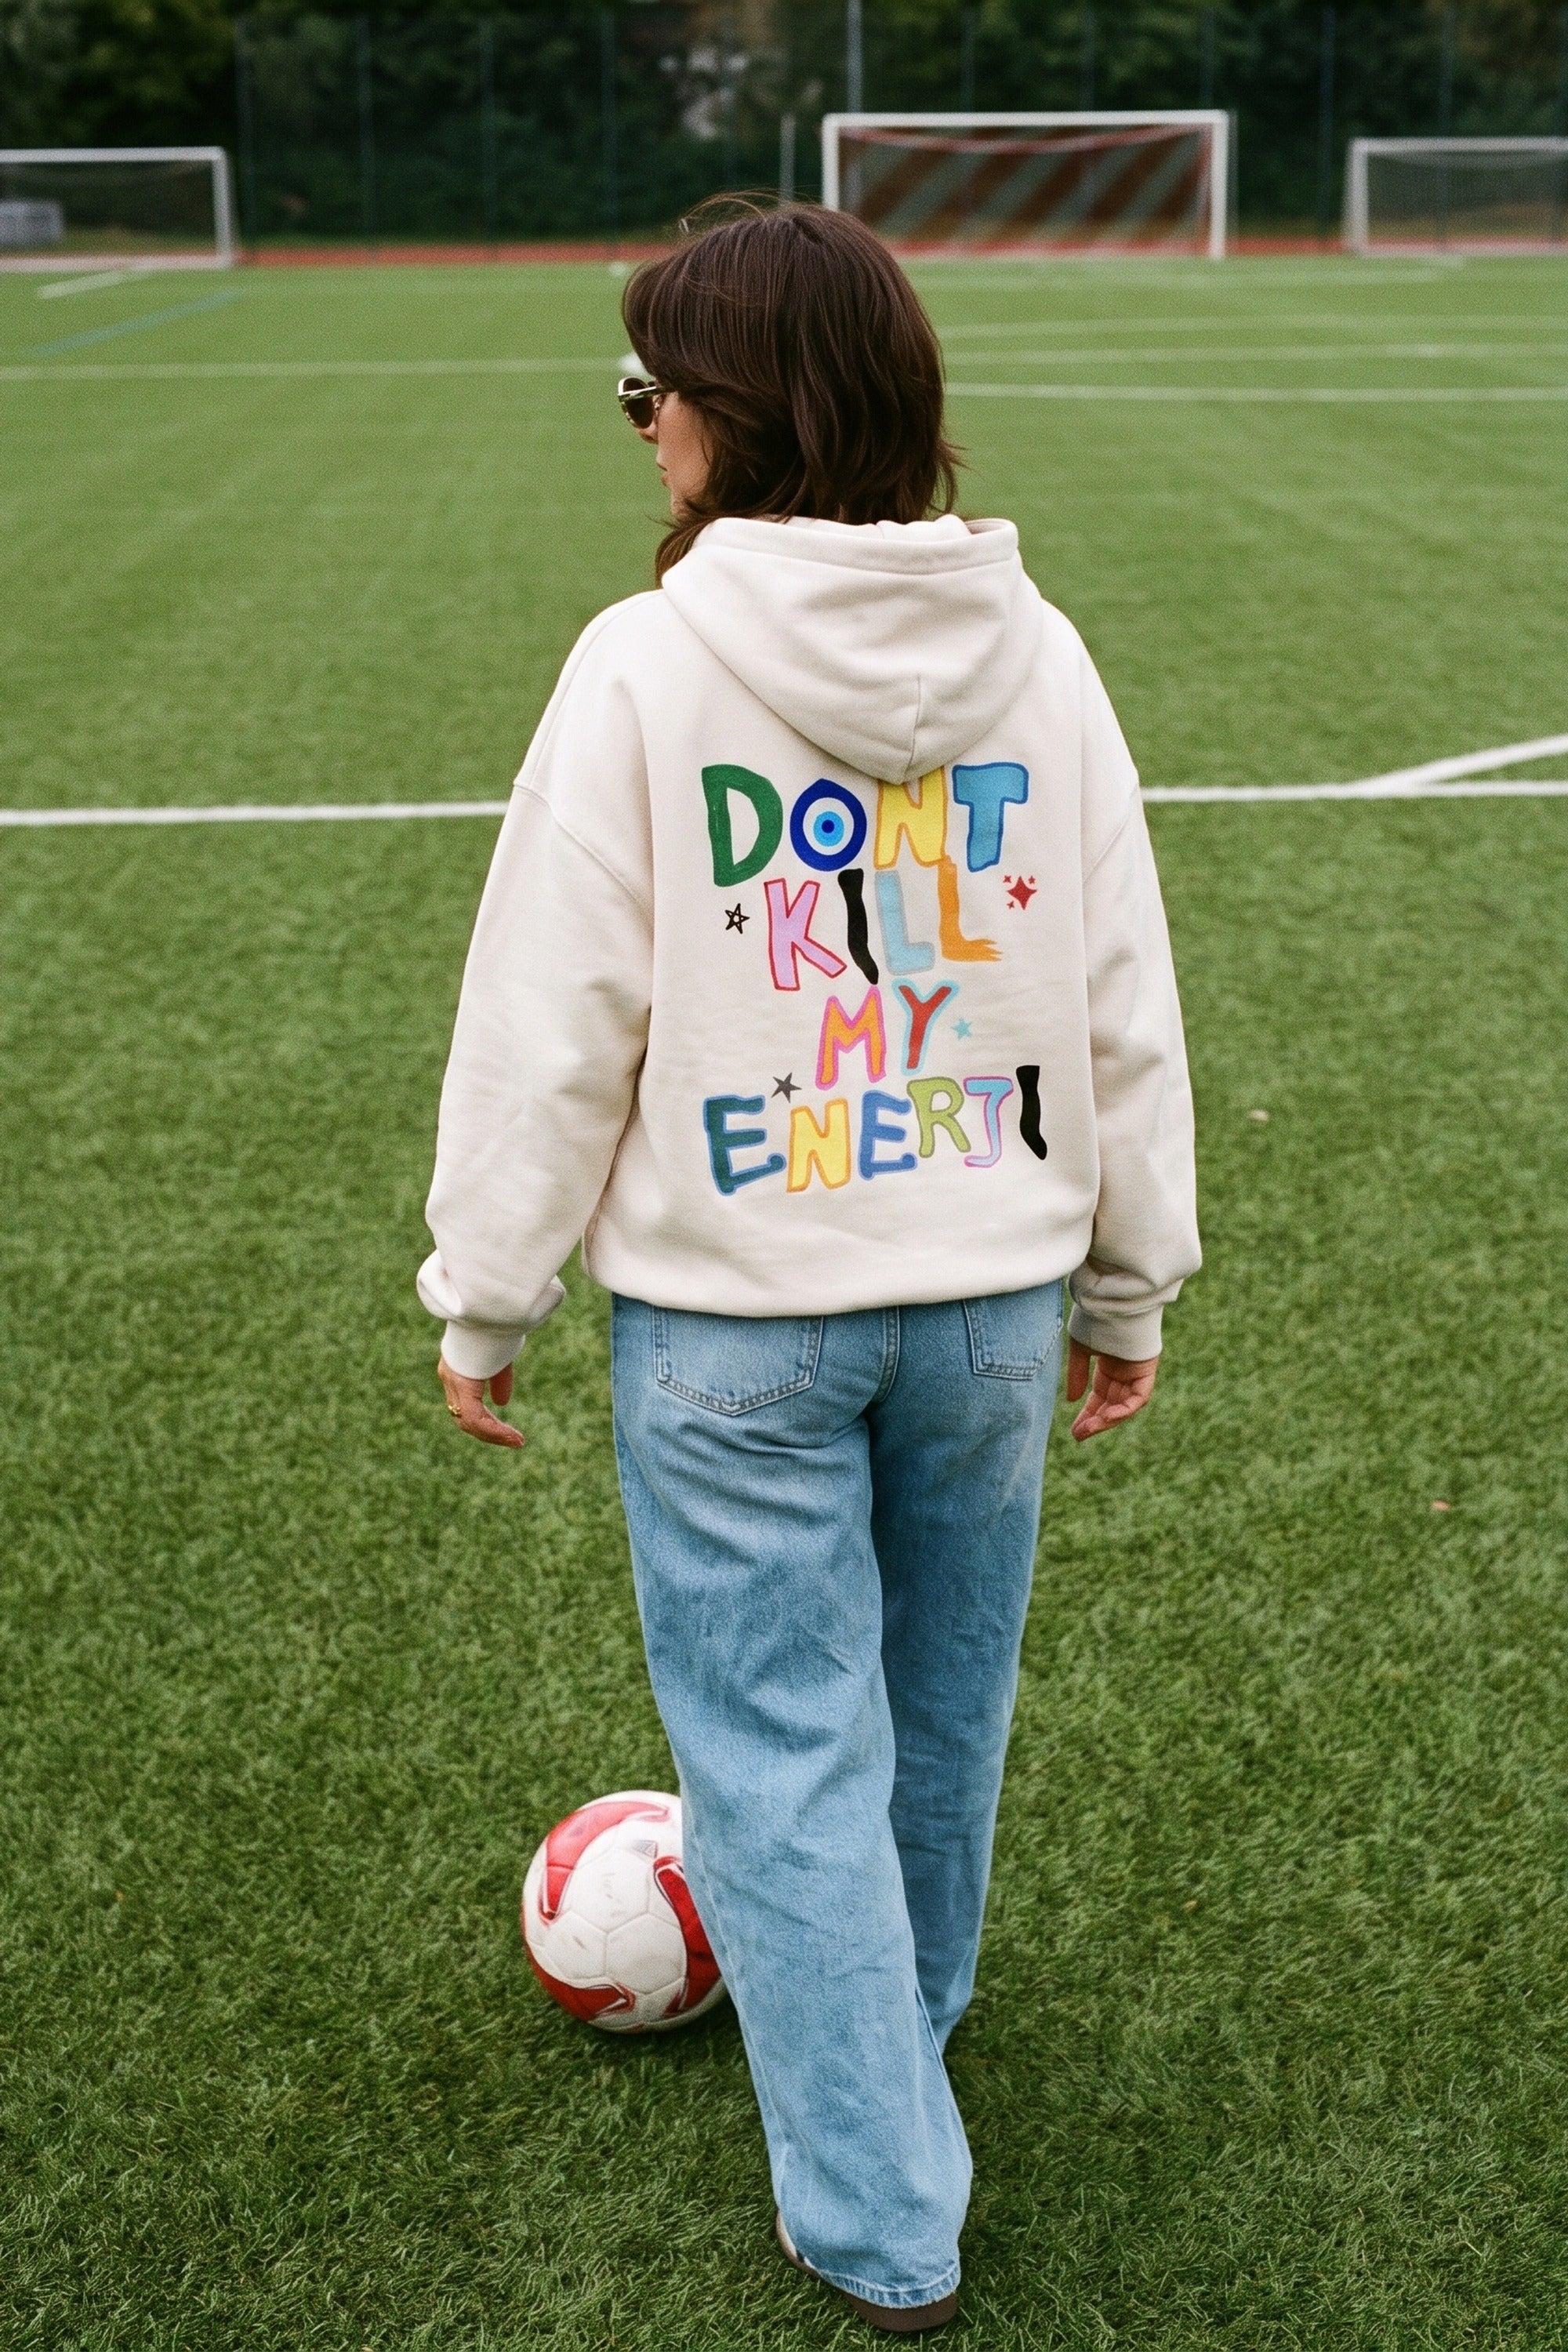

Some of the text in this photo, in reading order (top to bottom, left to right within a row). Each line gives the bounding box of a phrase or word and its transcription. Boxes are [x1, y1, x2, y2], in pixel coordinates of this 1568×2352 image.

[702, 762, 1029, 887] DONT
[764, 855, 1004, 991] KILL
[815, 978, 960, 1091] MY
[702, 1065, 1048, 1196] ENERJI
